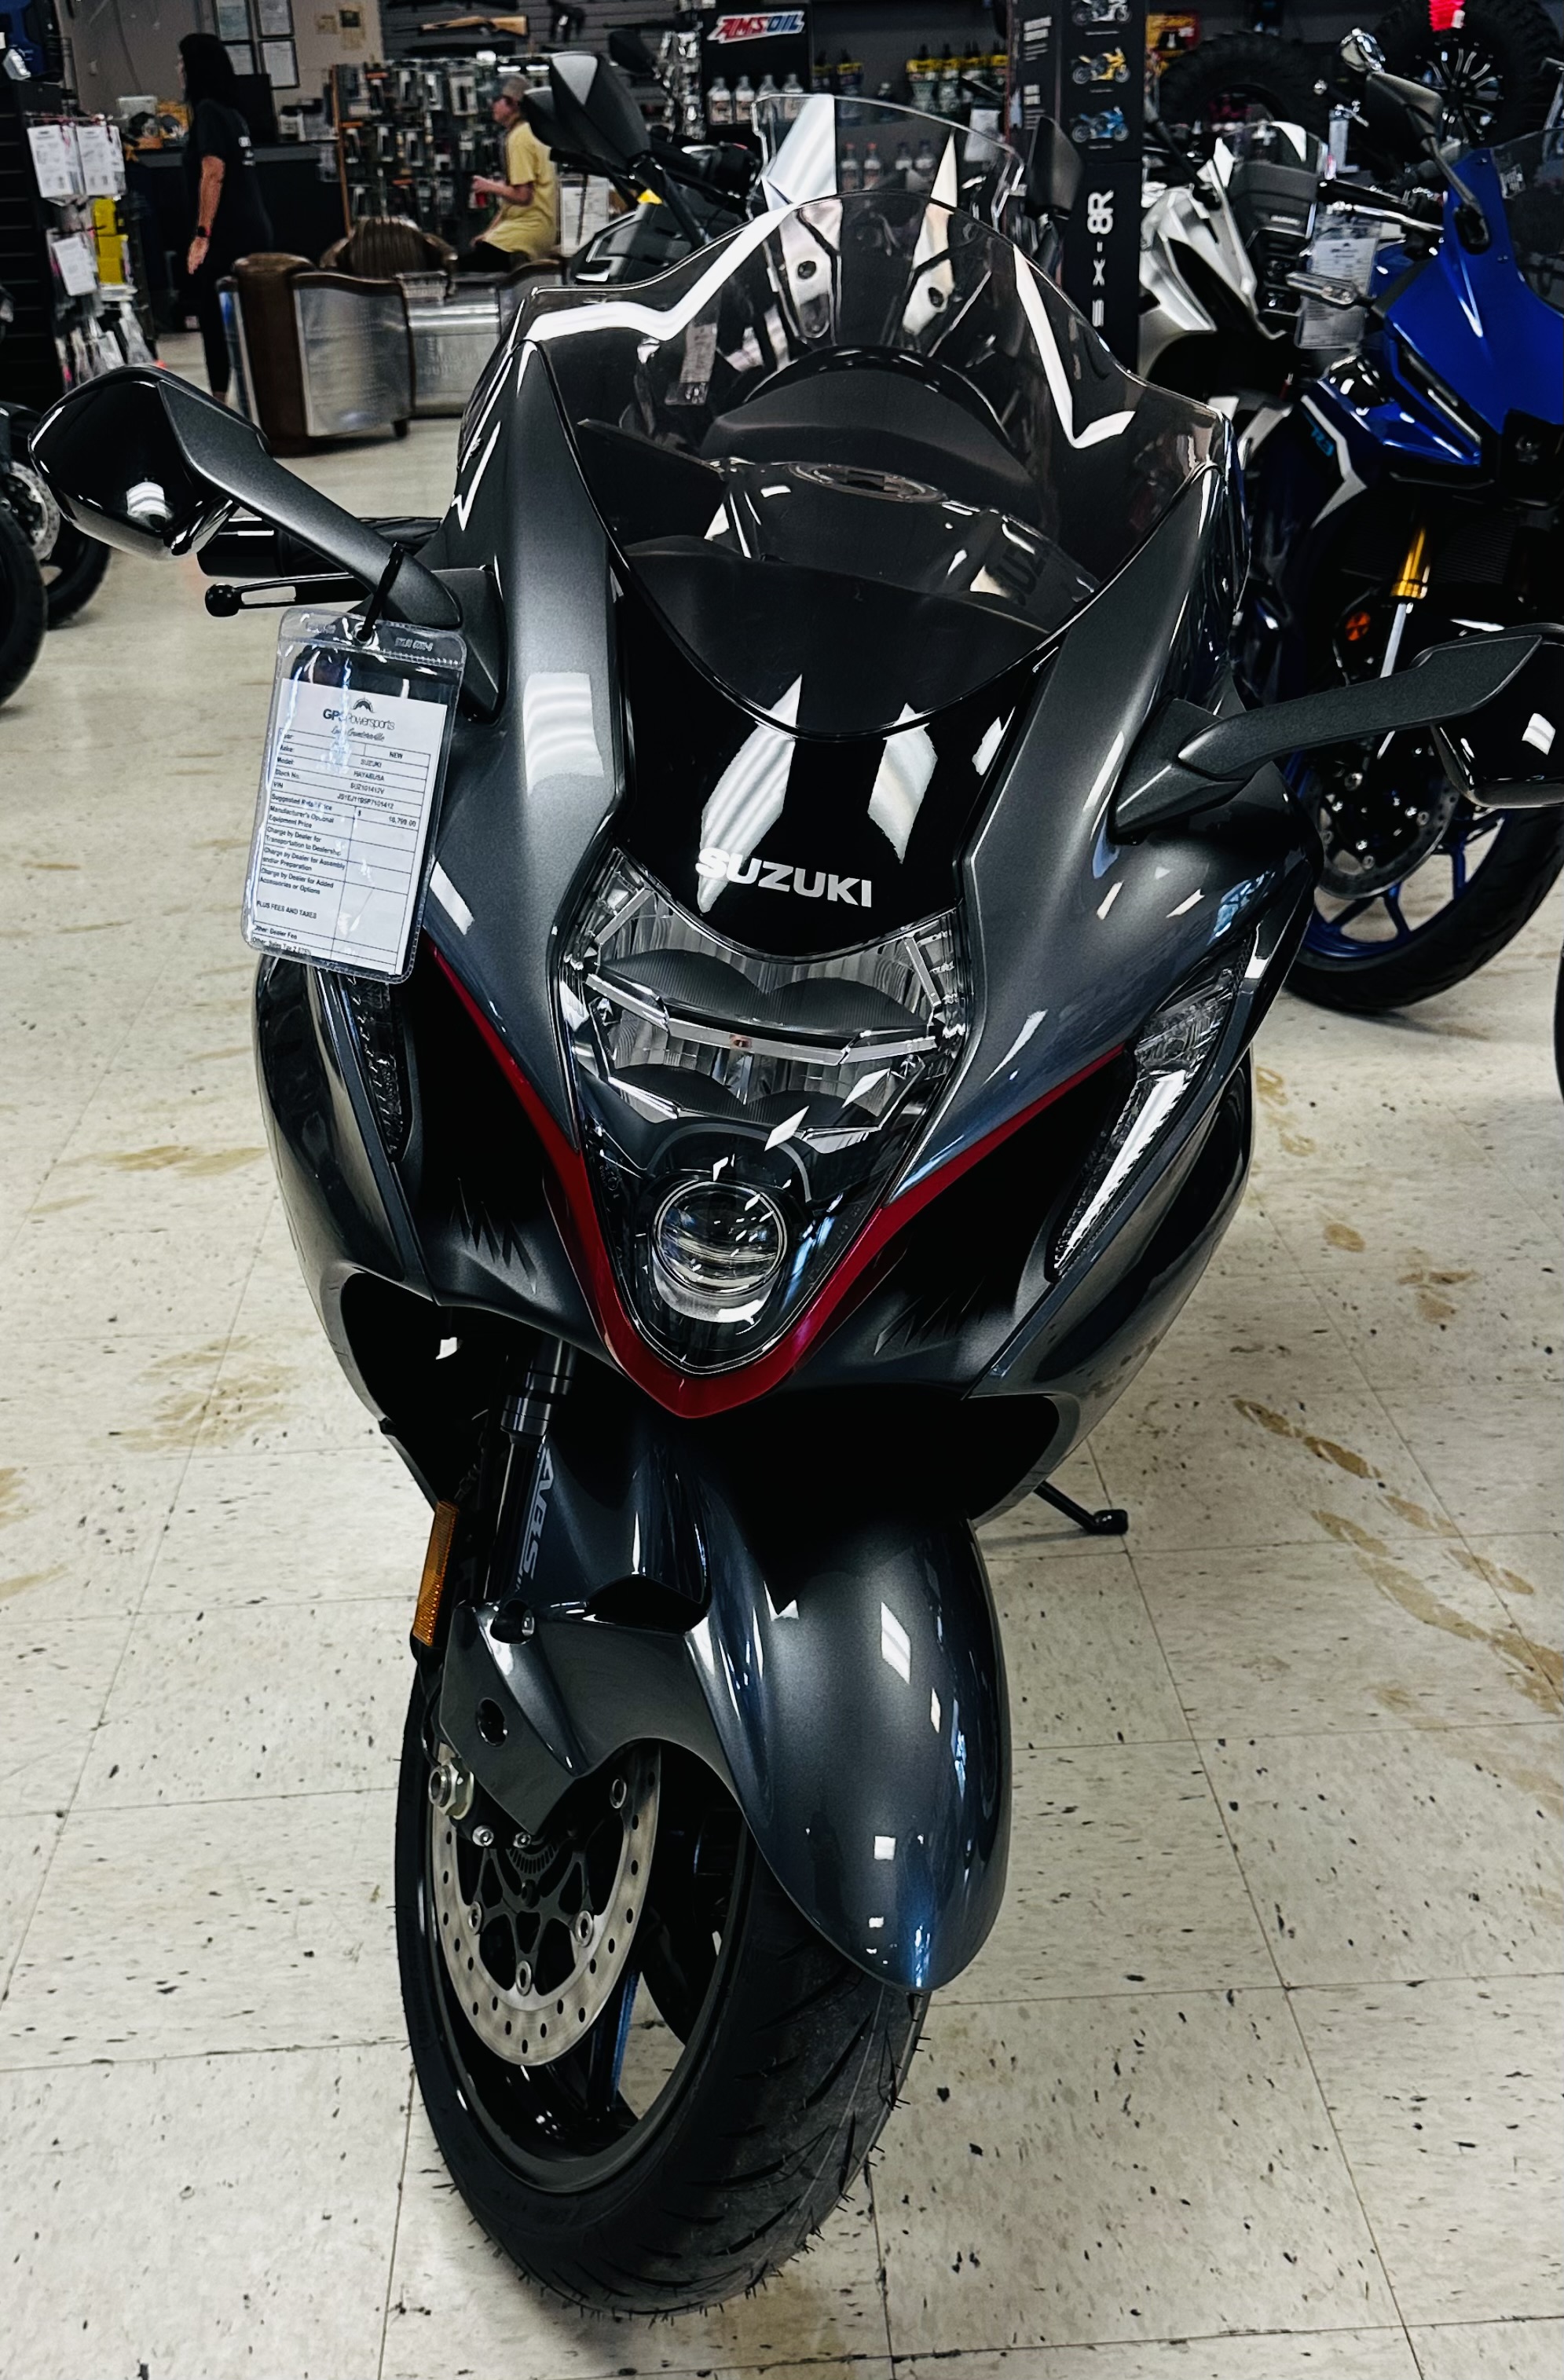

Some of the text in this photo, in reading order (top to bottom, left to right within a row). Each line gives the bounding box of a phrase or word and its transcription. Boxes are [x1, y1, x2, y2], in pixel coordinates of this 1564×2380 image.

[712, 13, 803, 40] AMSOIL
[360, 759, 383, 768] SUZUKI
[353, 771, 384, 782] HAYABUSA
[271, 793, 300, 805] Suggested
[317, 802, 332, 811] Pice
[269, 805, 310, 818] Manufacturer's
[269, 814, 312, 829] Equipment Price
[267, 826, 286, 837] Charge
[295, 832, 312, 840] Dealer
[266, 835, 305, 848] Transportation
[263, 847, 283, 857] Charge
[291, 853, 309, 862] Dealer
[319, 859, 346, 870] Assembly
[280, 859, 312, 871] Preparation
[261, 867, 280, 877] Charge
[288, 873, 306, 882] Dealer
[316, 879, 334, 888] Added
[695, 848, 872, 907] SUZUKI
[260, 877, 291, 888] Accessories
[299, 884, 320, 895] Options
[257, 900, 270, 909] PLUS
[271, 903, 284, 912] FEES
[299, 910, 317, 920] TAXES
[269, 928, 287, 937] Dealer
[287, 932, 298, 940] Fee
[523, 1447, 554, 1580] ABS
